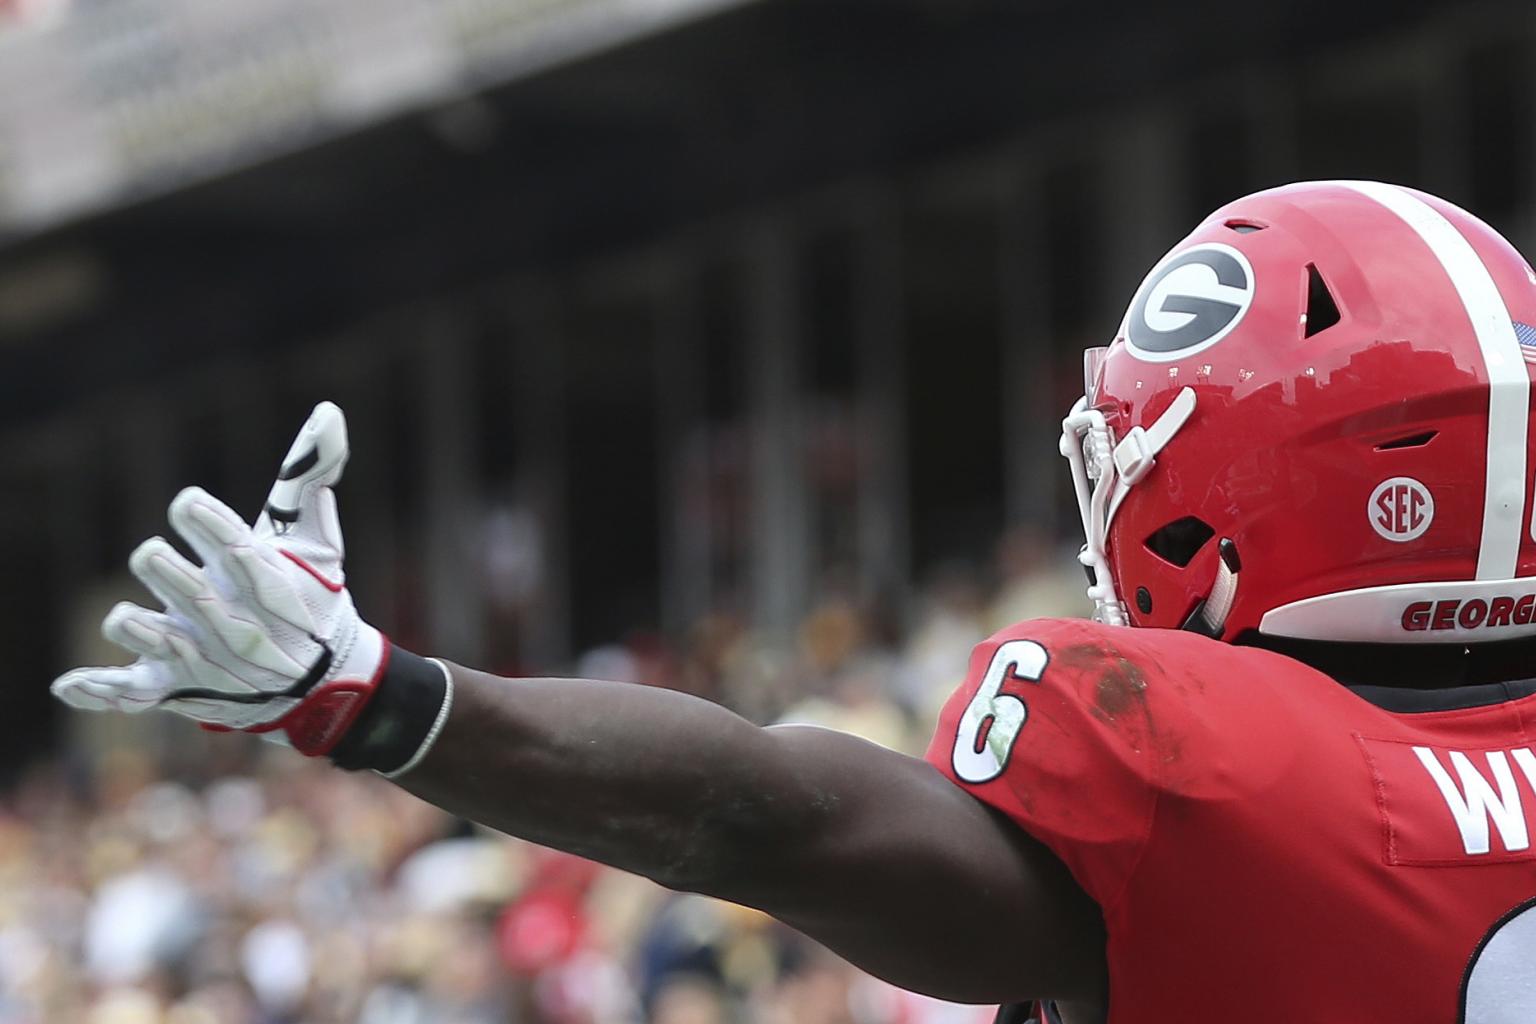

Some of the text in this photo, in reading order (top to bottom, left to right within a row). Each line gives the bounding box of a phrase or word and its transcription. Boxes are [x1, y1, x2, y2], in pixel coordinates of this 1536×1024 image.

[1127, 248, 1250, 354] G
[1375, 484, 1426, 534] SEC
[951, 638, 1050, 785] 6
